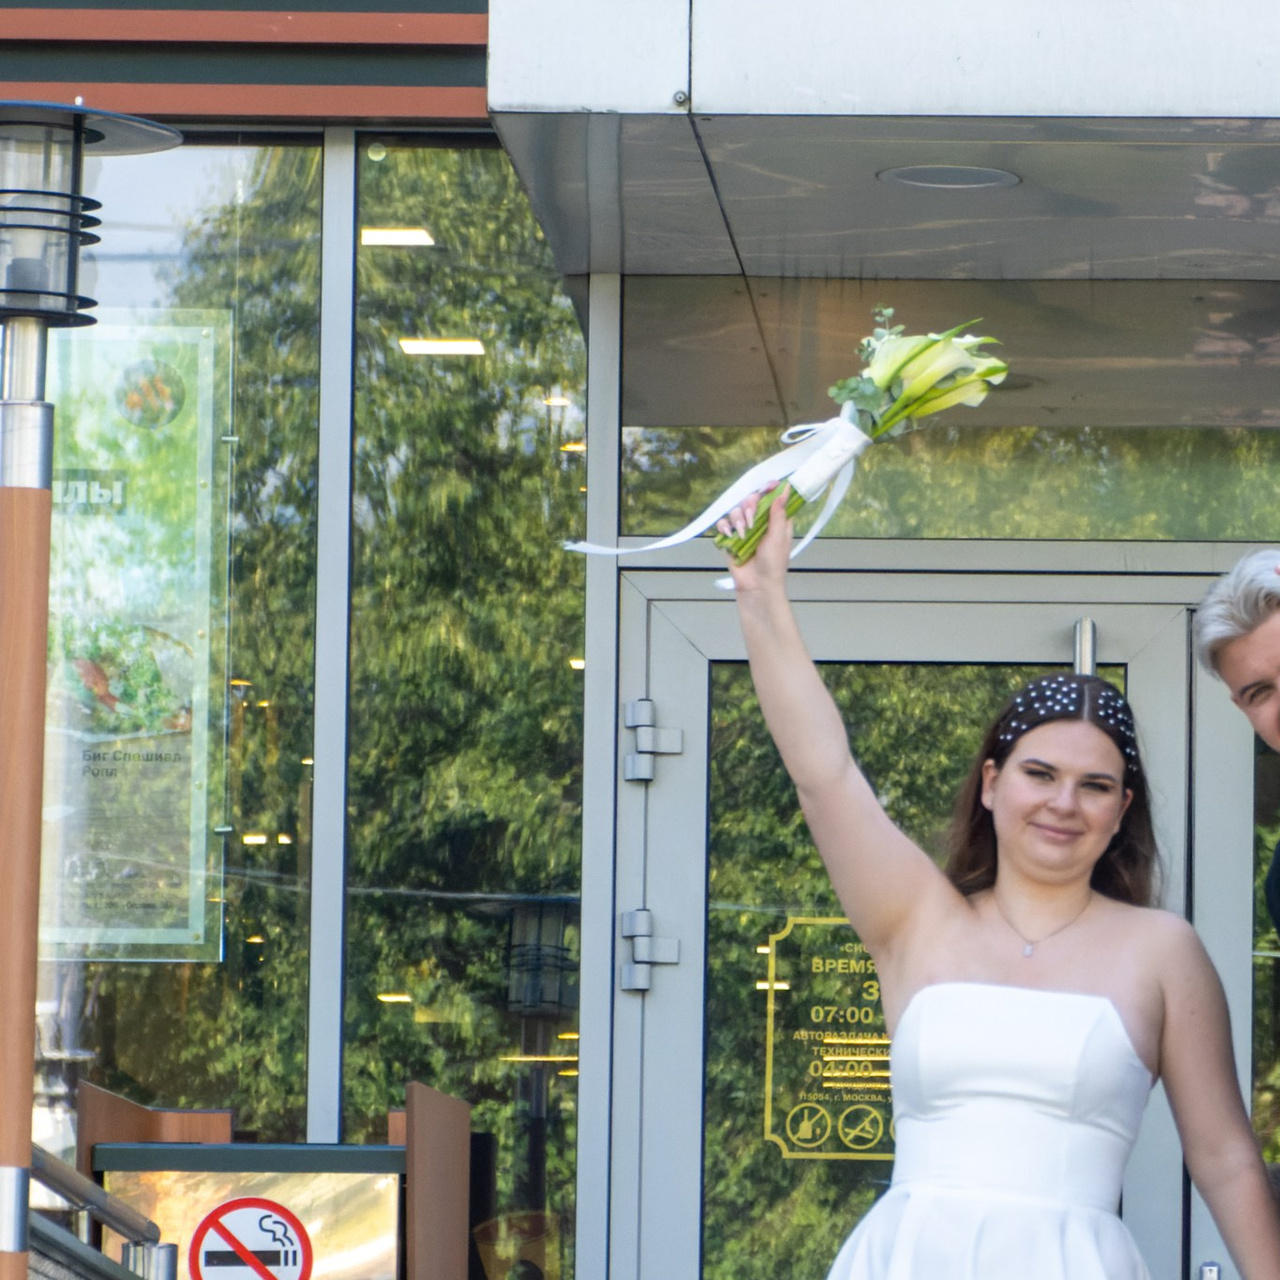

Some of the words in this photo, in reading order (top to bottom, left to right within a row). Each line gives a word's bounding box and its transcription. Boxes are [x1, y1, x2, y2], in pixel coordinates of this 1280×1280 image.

[82, 749, 109, 762] Биг
[112, 750, 182, 762] Спешиал
[811, 957, 878, 974] ВРЕМЯ
[810, 1006, 874, 1024] 07:00
[792, 1030, 879, 1041] АВТОРАЗДАЧА
[809, 1060, 873, 1078] 04:00
